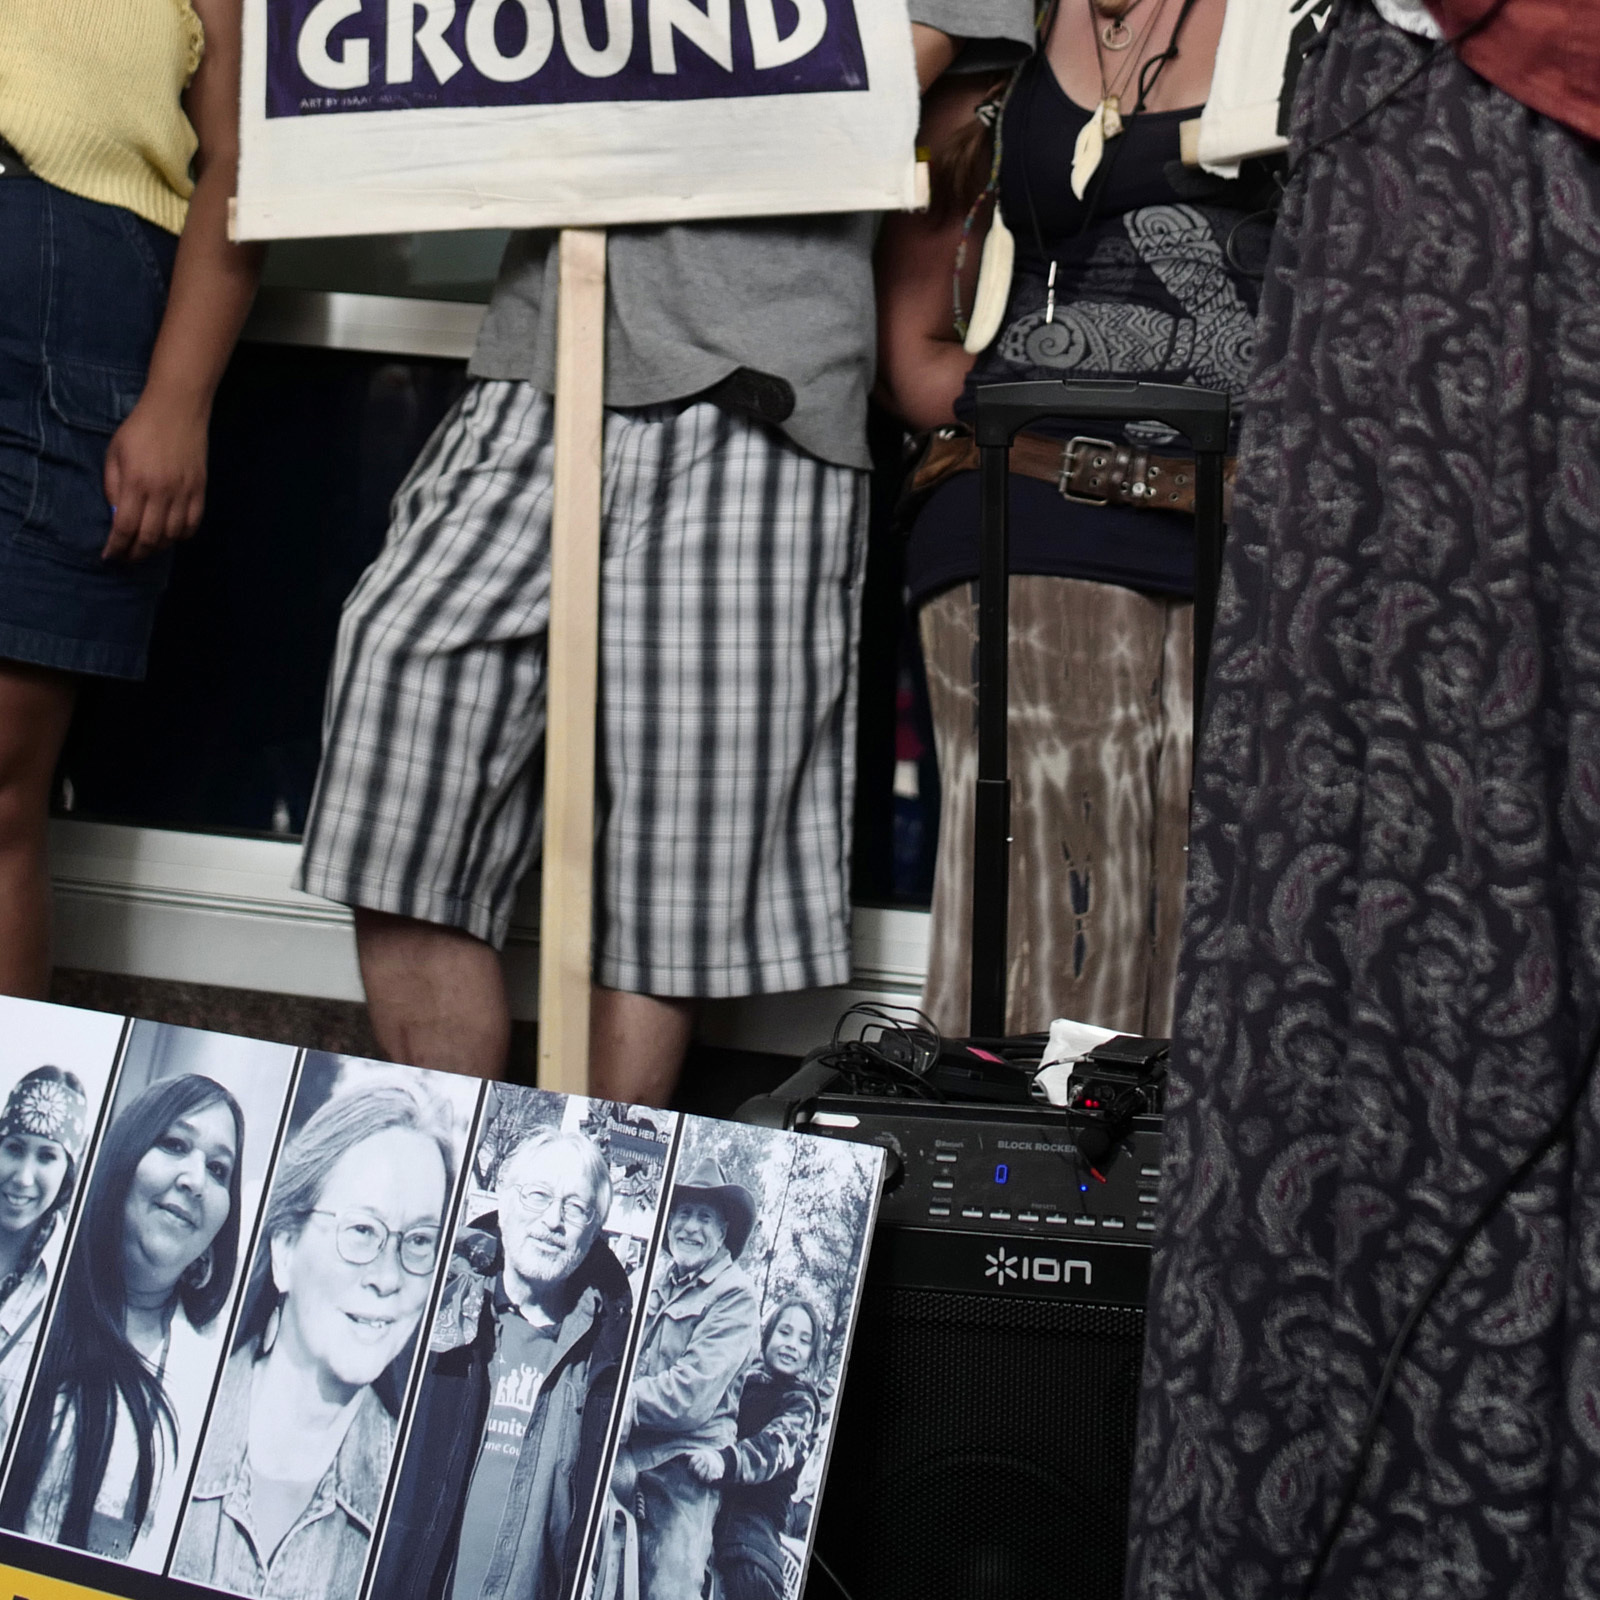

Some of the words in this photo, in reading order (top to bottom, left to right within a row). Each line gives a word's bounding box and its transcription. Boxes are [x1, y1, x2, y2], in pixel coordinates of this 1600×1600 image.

[612, 1122, 638, 1137] BRING
[638, 1128, 655, 1141] HER
[997, 1140, 1033, 1151] BLOCK
[1035, 1142, 1078, 1153] ROCKER
